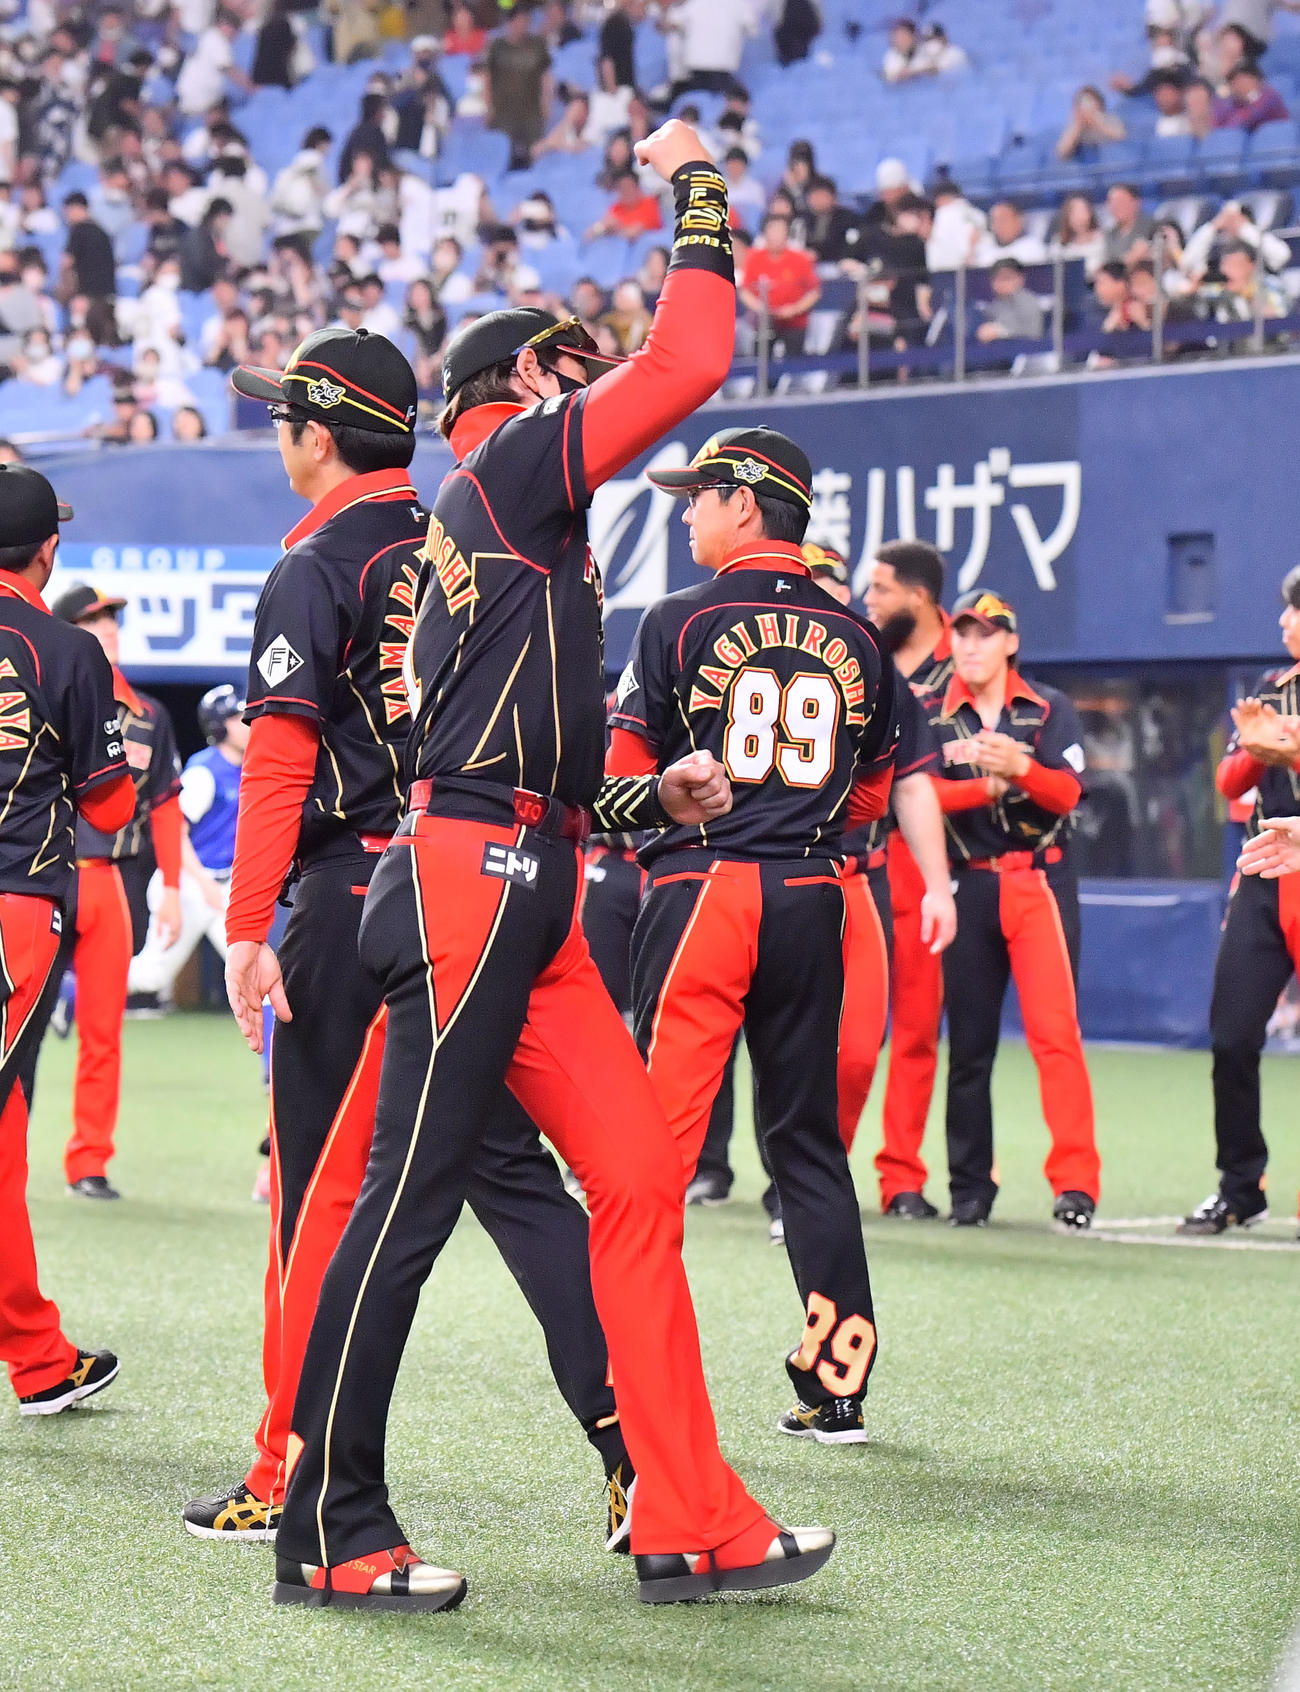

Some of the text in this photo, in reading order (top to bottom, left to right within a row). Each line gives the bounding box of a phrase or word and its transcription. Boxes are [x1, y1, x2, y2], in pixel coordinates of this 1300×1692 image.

[91, 547, 226, 571] GROUP
[688, 612, 866, 726] YAGIHIROSHI
[722, 665, 841, 790] 89
[485, 846, 538, 882] ニトリ
[788, 1290, 877, 1398] 89
